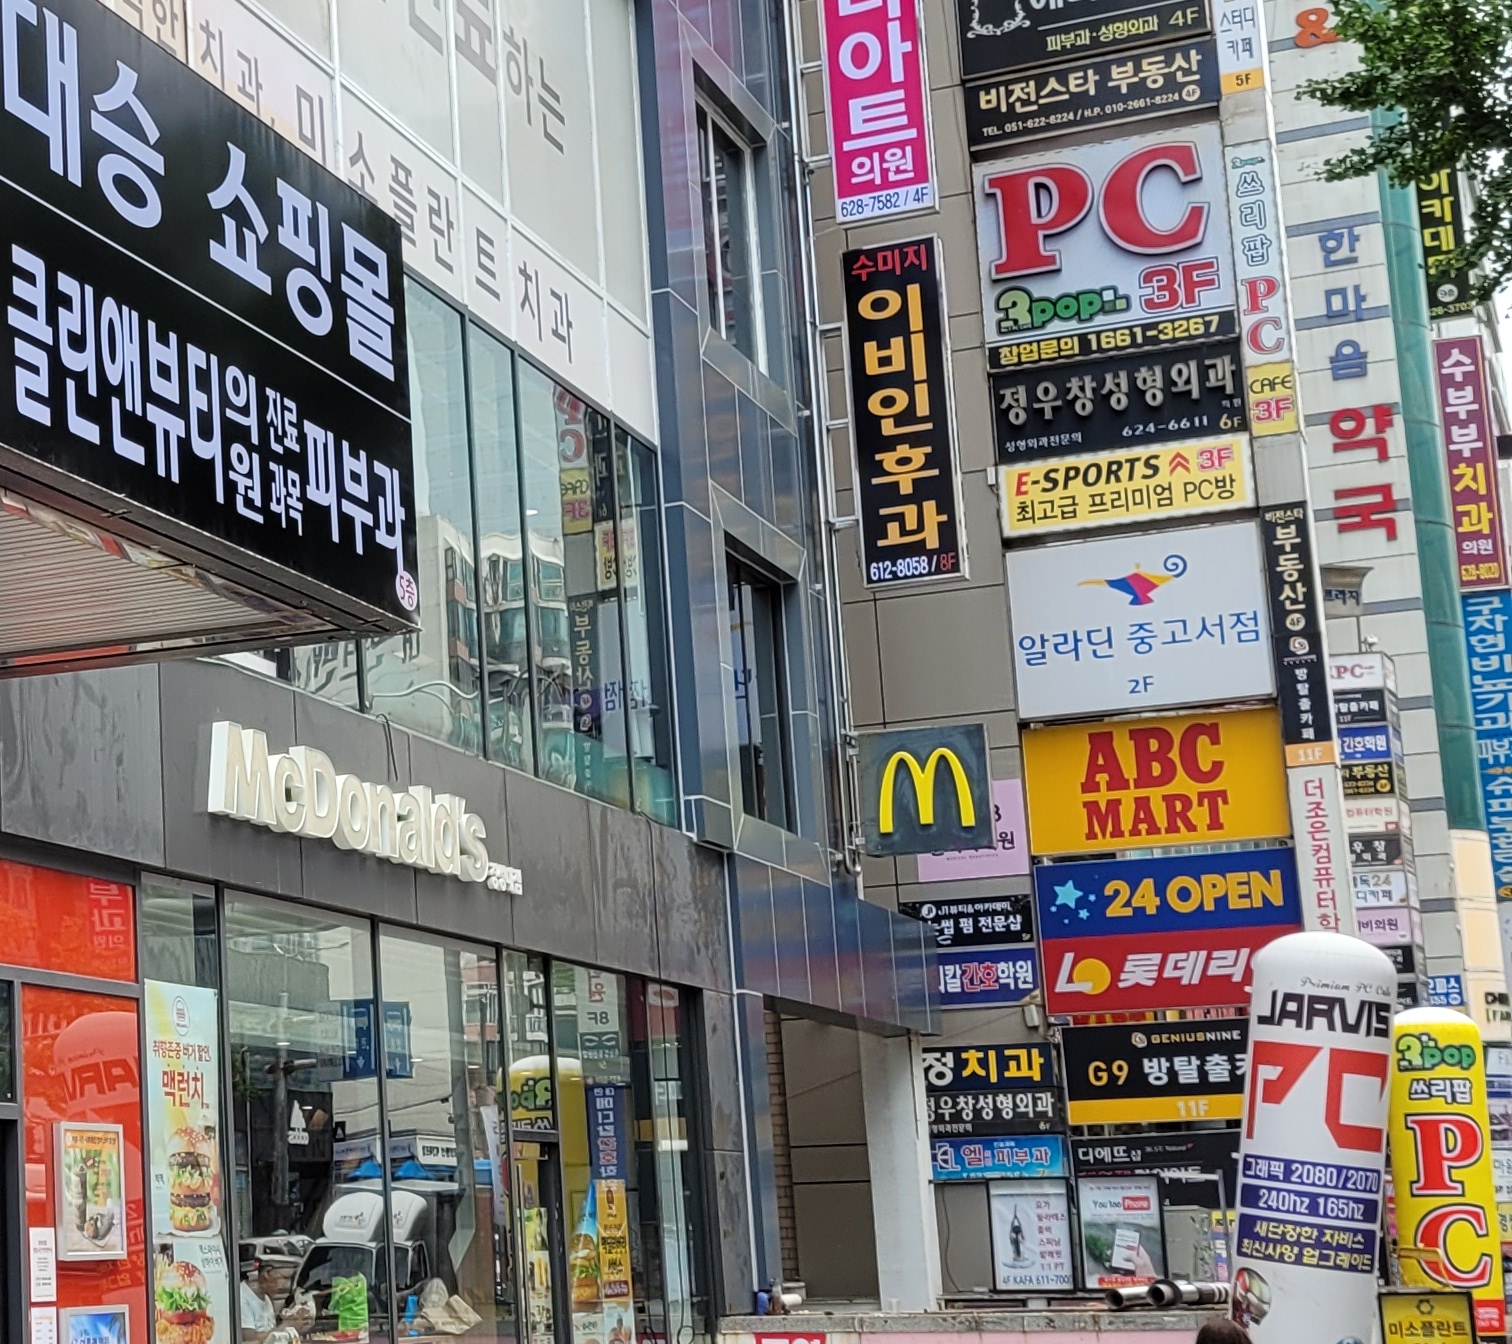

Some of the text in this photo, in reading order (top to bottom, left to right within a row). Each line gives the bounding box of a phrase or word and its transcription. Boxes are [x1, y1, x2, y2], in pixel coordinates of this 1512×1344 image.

[1168, 6, 1200, 27] 4F
[1220, 6, 1256, 33] 스터디
[1226, 37, 1254, 61] 카페
[979, 49, 1202, 113] 비전스타 부동산
[1235, 73, 1252, 87] 5F
[850, 145, 915, 186] 의원
[841, 186, 929, 218] 628-7582 4F
[983, 141, 1210, 282] PC
[1236, 170, 1272, 267] 쓰리팝
[208, 141, 397, 383] 쇼핑몰
[851, 244, 928, 281] 수미지
[1138, 257, 1219, 313] 3F
[1318, 228, 1368, 382] 한마음
[1241, 276, 1284, 354] PC
[999, 315, 1219, 365] 창업문의 1661-3267
[999, 355, 1236, 426] 정우창성형외과
[1249, 374, 1293, 394] CAFE
[265, 385, 300, 455] 진료
[857, 283, 948, 550] 이비인후과
[1122, 415, 1208, 437] 624-6611
[1219, 414, 1241, 430] 6F
[1254, 396, 1293, 423] 3F
[1014, 446, 1234, 497] E-SPORTS 3F
[1329, 403, 1397, 541] 약국
[268, 468, 304, 535] 과목
[305, 421, 407, 572] 피부과
[1016, 474, 1236, 526] 최고급 프리미엄 PC방
[870, 552, 957, 582] 612-8058 8F
[1273, 524, 1307, 612] 부동산
[1462, 539, 1493, 555] 의원
[1019, 610, 1261, 667] 알라딘 중고서점
[1288, 616, 1302, 628] 4F
[1128, 676, 1154, 695] 2F
[1080, 722, 1225, 794] ABC
[1297, 748, 1323, 762] 11F
[208, 721, 489, 882] McDonald's
[1082, 789, 1229, 841] MART
[1104, 868, 1285, 918] 24 OPEN
[959, 914, 1022, 934] 펌 전문샵
[1117, 947, 1252, 989] 롯데리
[1257, 990, 1390, 1038] JARVIS
[162, 1068, 204, 1109] 맥런치
[1088, 1060, 1129, 1086] G9
[1409, 1078, 1473, 1104] 쓰리팝
[1176, 1100, 1210, 1116] 11F
[1245, 1040, 1388, 1152] PC
[1244, 1157, 1379, 1194] 그래픽 2080/2070
[1258, 1188, 1365, 1221] 240hz 165hz
[1405, 1113, 1492, 1288] PC
[1240, 1238, 1372, 1273] 최신사양 업그레이드
[1253, 1220, 1365, 1250] 새단장한 자비스
[1389, 1321, 1469, 1338] 미소플란트
